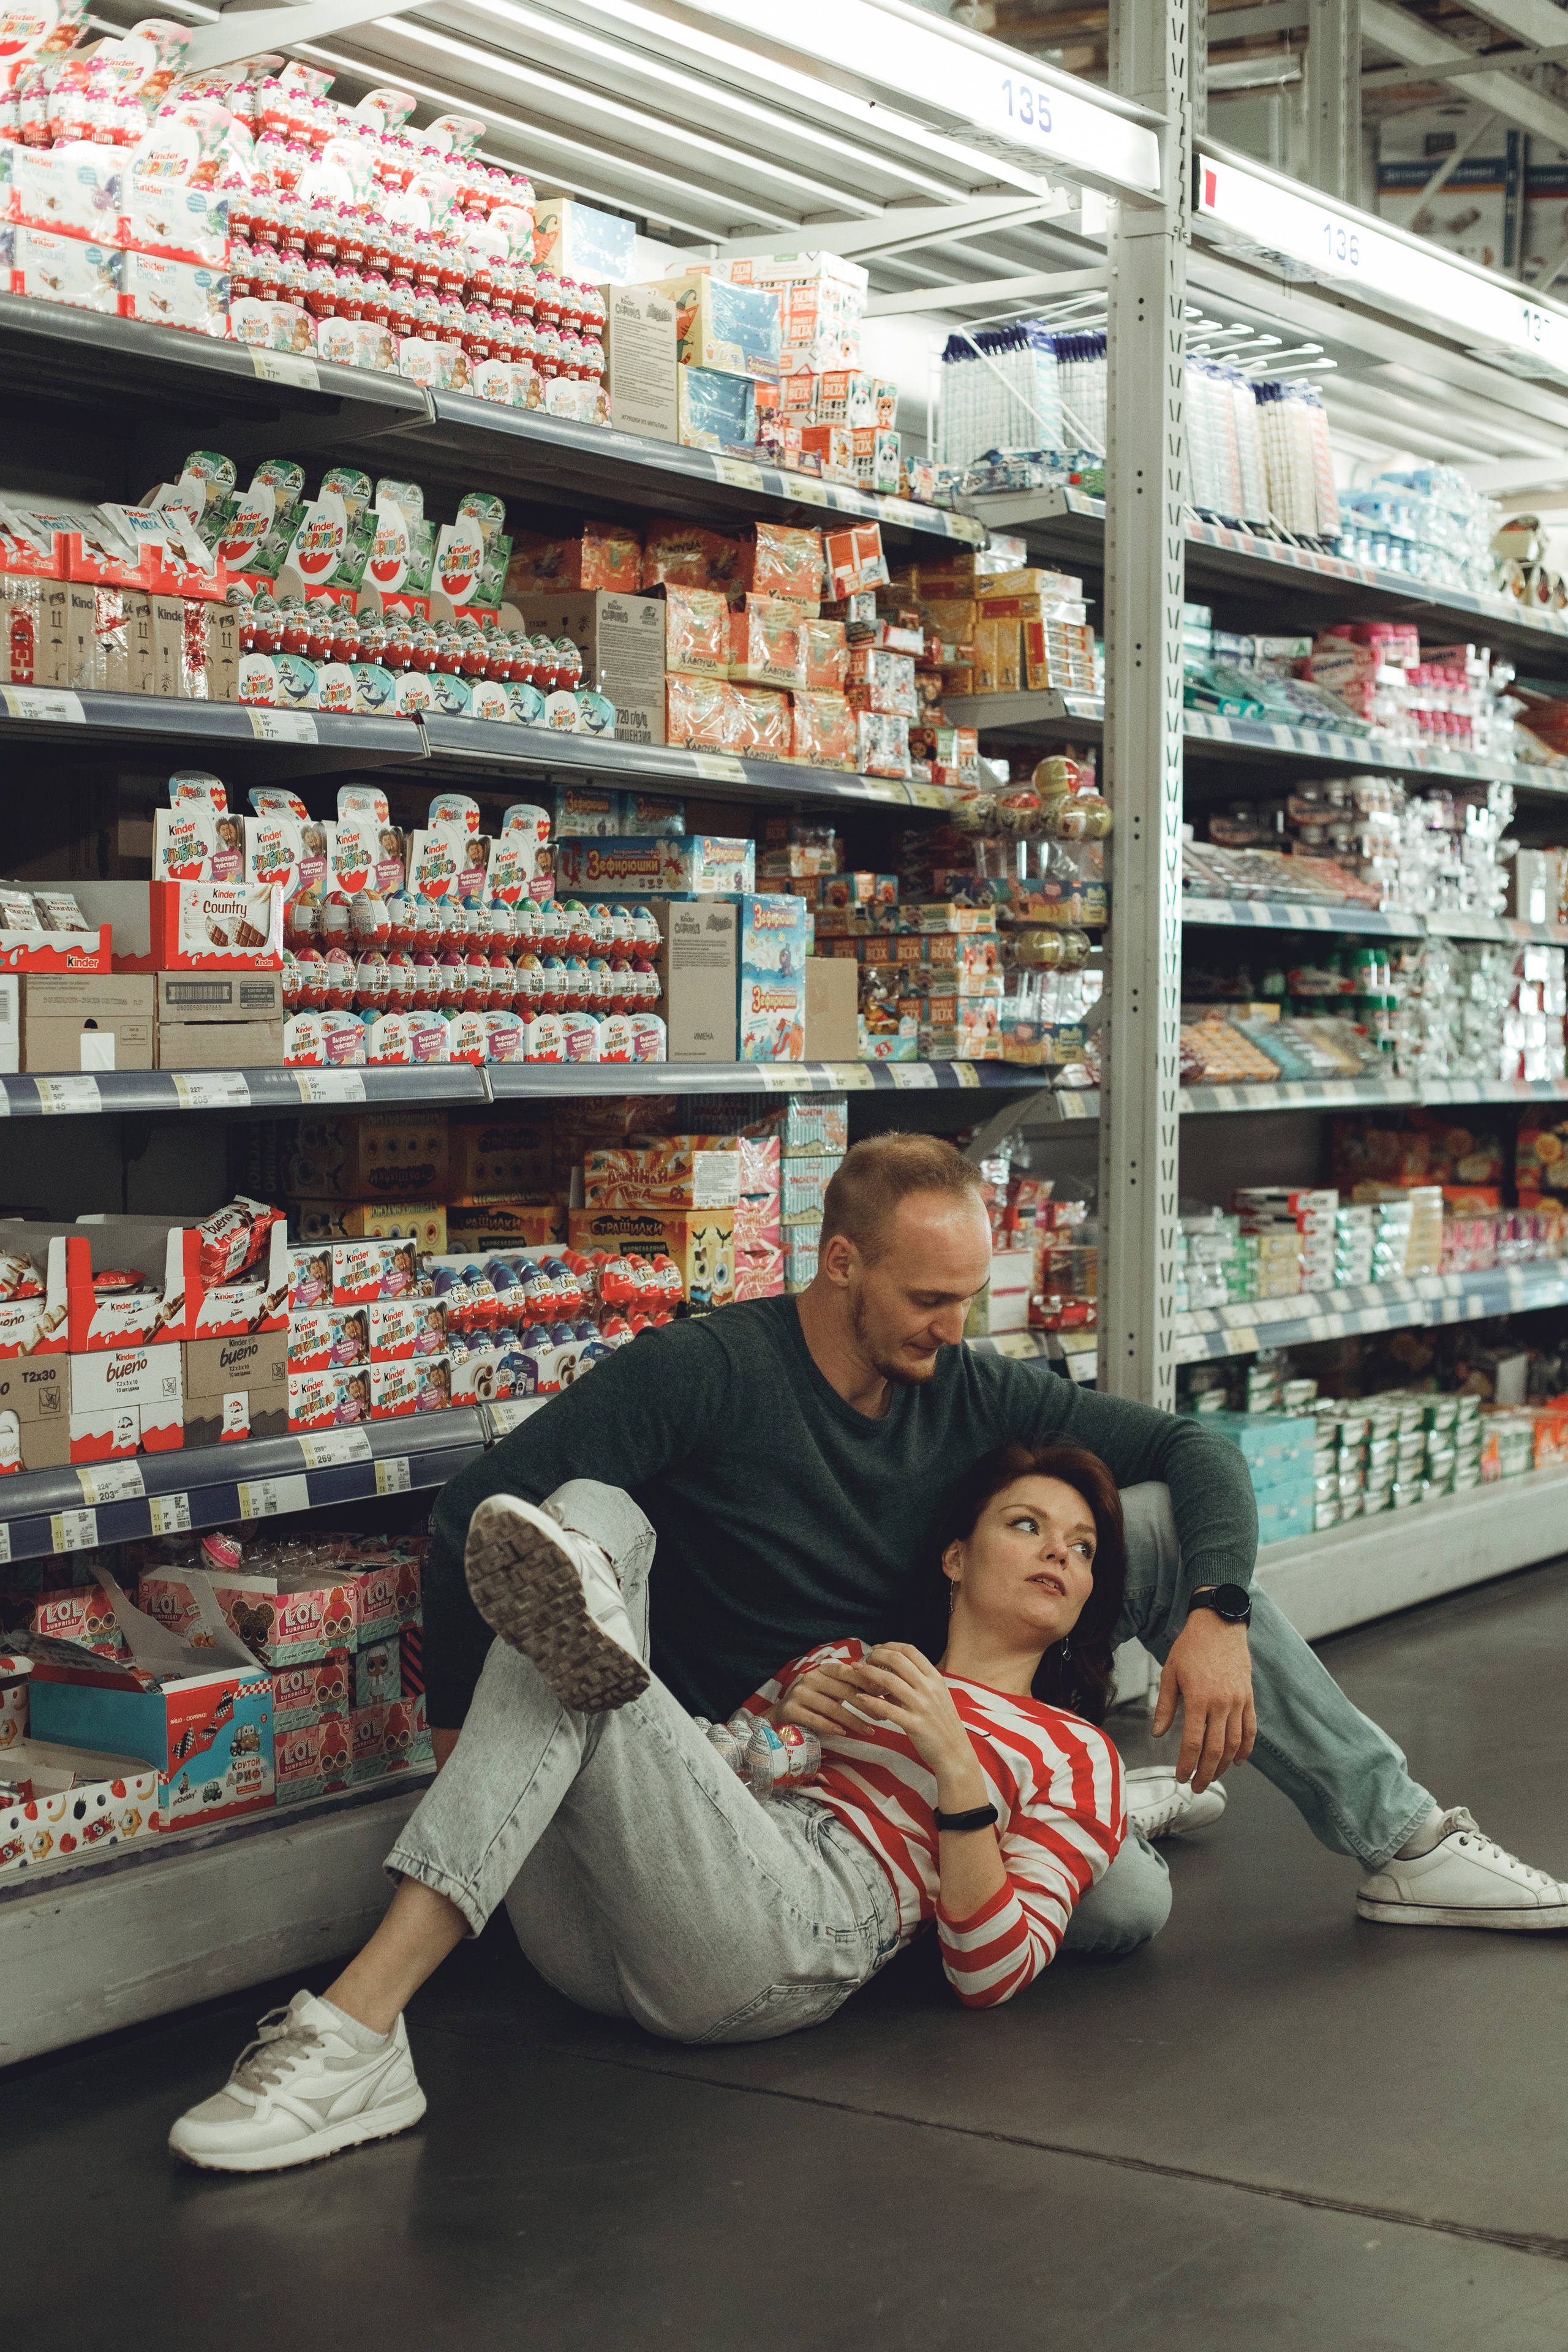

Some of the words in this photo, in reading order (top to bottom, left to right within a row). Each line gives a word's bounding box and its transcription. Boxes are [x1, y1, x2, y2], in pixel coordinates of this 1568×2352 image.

[1001, 79, 1052, 133] 135
[1324, 224, 1359, 266] 136
[790, 322, 815, 339] BOX
[823, 373, 848, 385] SWEET
[823, 382, 846, 398] BOX
[129, 517, 161, 532] Maxi
[214, 855, 238, 864] Выразить
[301, 861, 324, 870] Выразить
[587, 850, 660, 879] Зефирюшки
[377, 864, 400, 872] Выразить
[213, 888, 236, 899] Kinder
[47, 905, 79, 914] Country
[203, 900, 247, 919] Country
[67, 954, 99, 969] Kinder
[752, 986, 797, 1014] Зефирюшки
[931, 1009, 954, 1023] BOX
[332, 1033, 356, 1044] Выразить
[334, 1039, 355, 1050] чувства?
[418, 1032, 442, 1043] Выразить
[420, 1039, 441, 1050] чувства?
[495, 1033, 518, 1043] Выразить
[496, 1039, 516, 1049] чувства?
[572, 1034, 593, 1043] Выразить
[573, 1040, 592, 1049] чувства?
[639, 1033, 660, 1043] Выразить
[640, 1040, 659, 1049] чувства?
[209, 1212, 233, 1235] bueno
[590, 1221, 663, 1237] СТРАШИЛКИ
[347, 1250, 369, 1264] Kinder
[383, 1309, 404, 1323] Kinder
[295, 1319, 318, 1333] Kinder
[116, 1353, 136, 1362] Kinder
[220, 1343, 258, 1368] bueno
[22, 1370, 56, 1384] T2x30
[106, 1358, 148, 1383] bueno
[384, 1368, 405, 1382] Kinder
[301, 1379, 323, 1395] Kinder
[368, 1599, 390, 1611] SURPRISE!
[46, 1618, 77, 1631] SURPRISE!
[285, 1622, 315, 1634] SURPRISE!
[280, 1688, 309, 1702] SURPRISE!
[232, 1757, 260, 1771] КРУТОЙ
[285, 1758, 313, 1771] SURPRISE!
